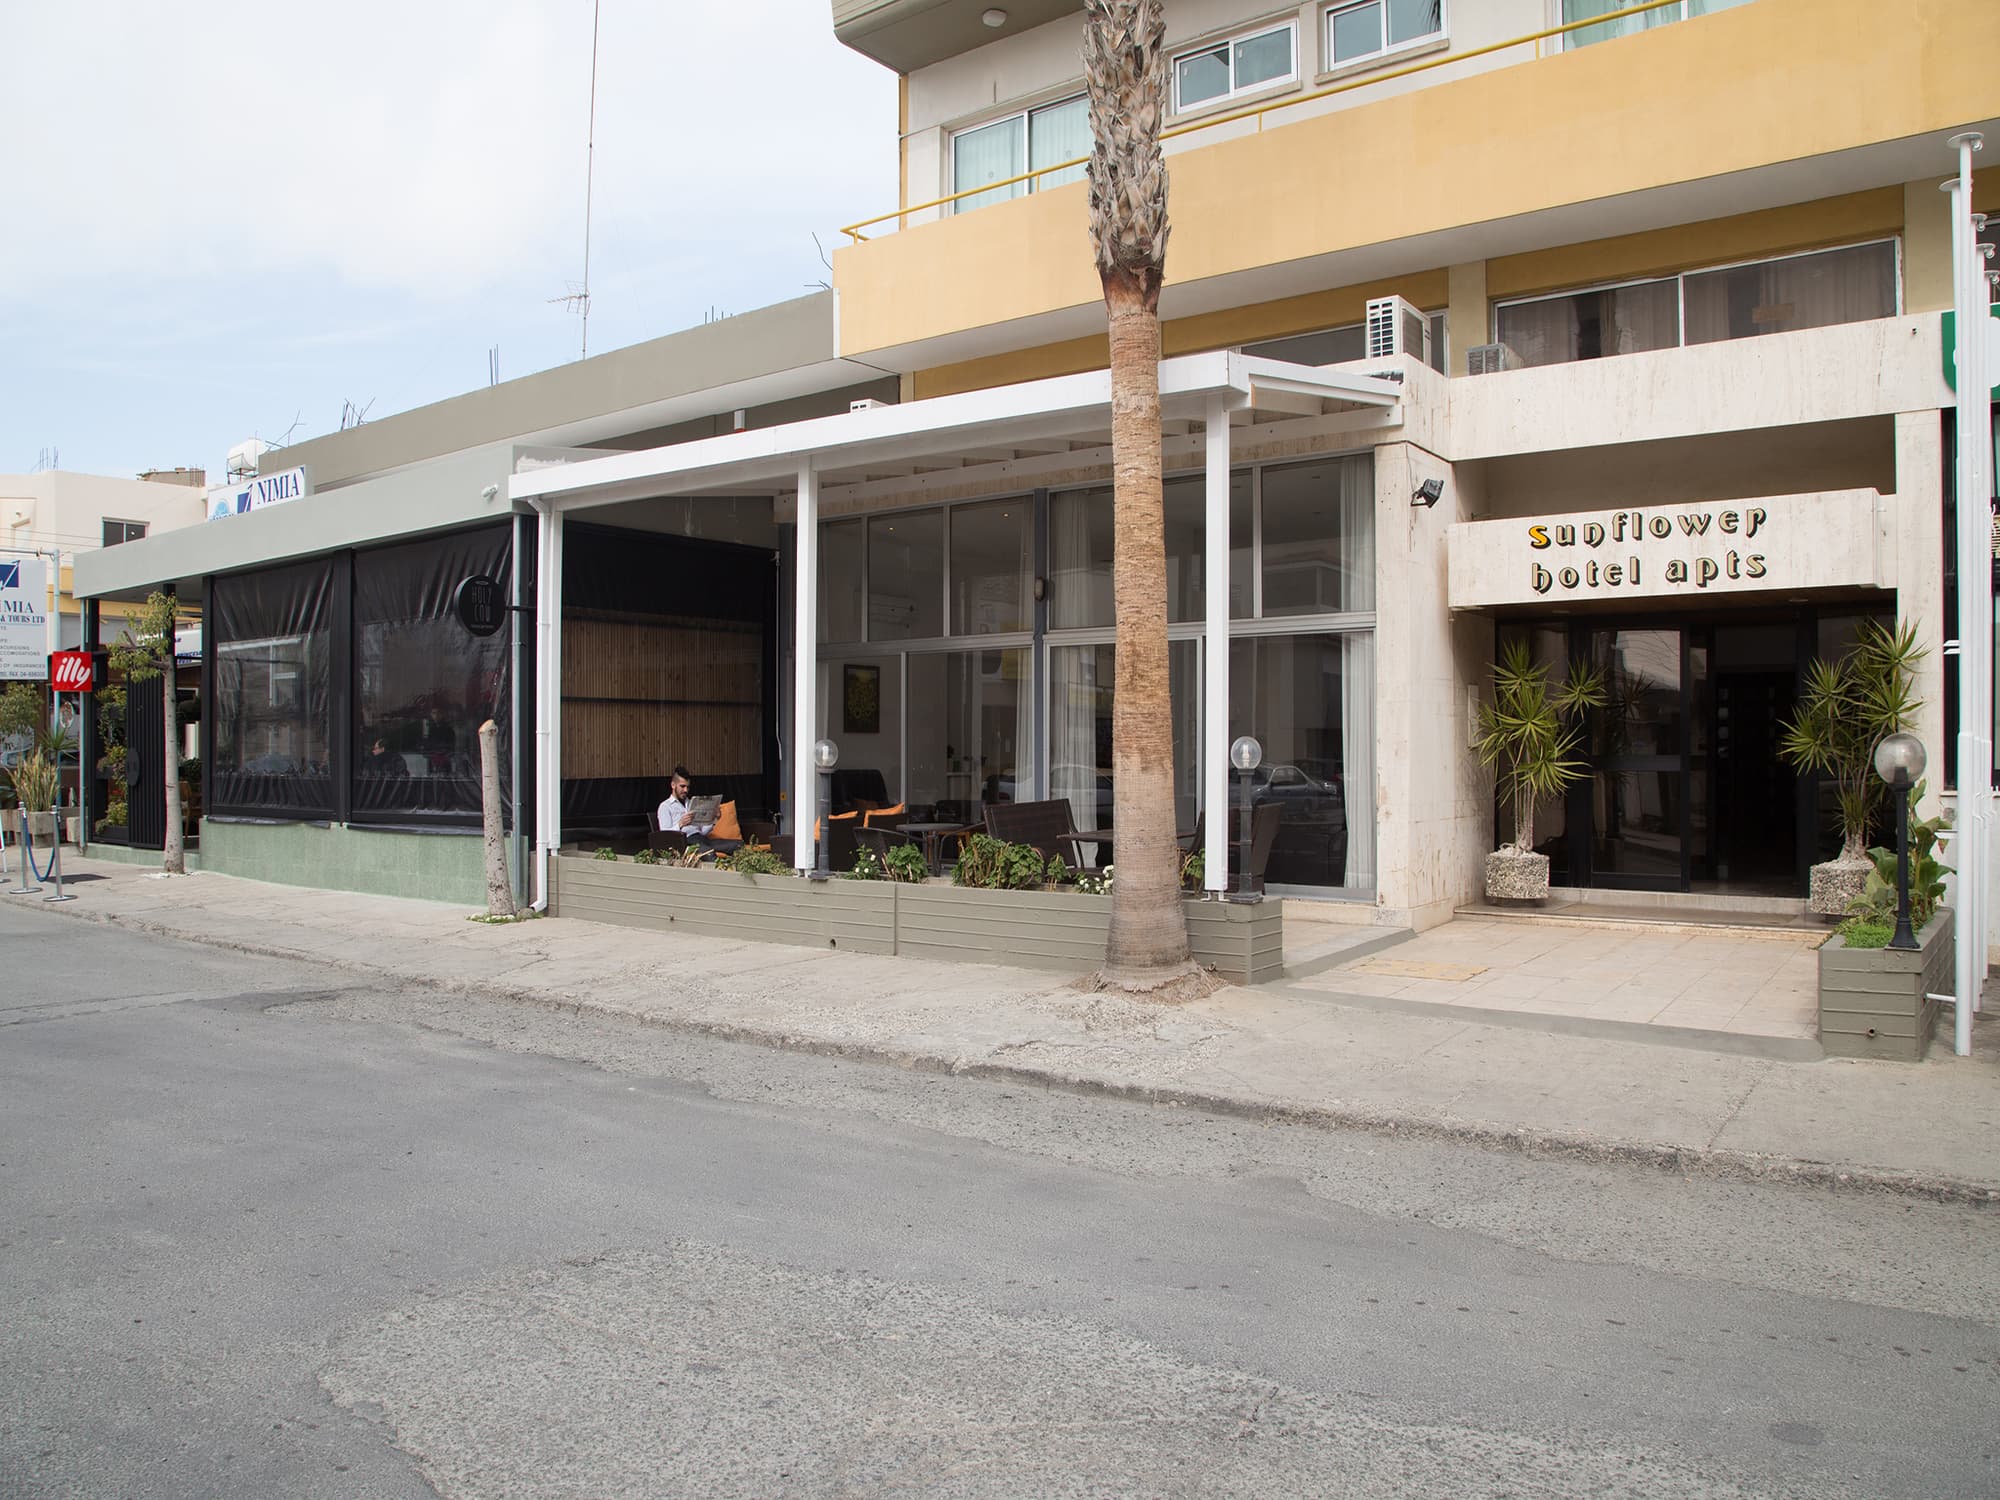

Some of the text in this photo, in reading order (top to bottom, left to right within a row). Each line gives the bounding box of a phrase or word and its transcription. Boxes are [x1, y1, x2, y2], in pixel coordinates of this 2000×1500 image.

[257, 472, 300, 504] NIMIA
[1528, 507, 1768, 549] sunflower
[1531, 549, 1768, 594] hotel apts
[0, 600, 34, 613] MIA
[8, 615, 30, 623] TOURS
[32, 615, 45, 624] LTD
[55, 657, 92, 688] illy
